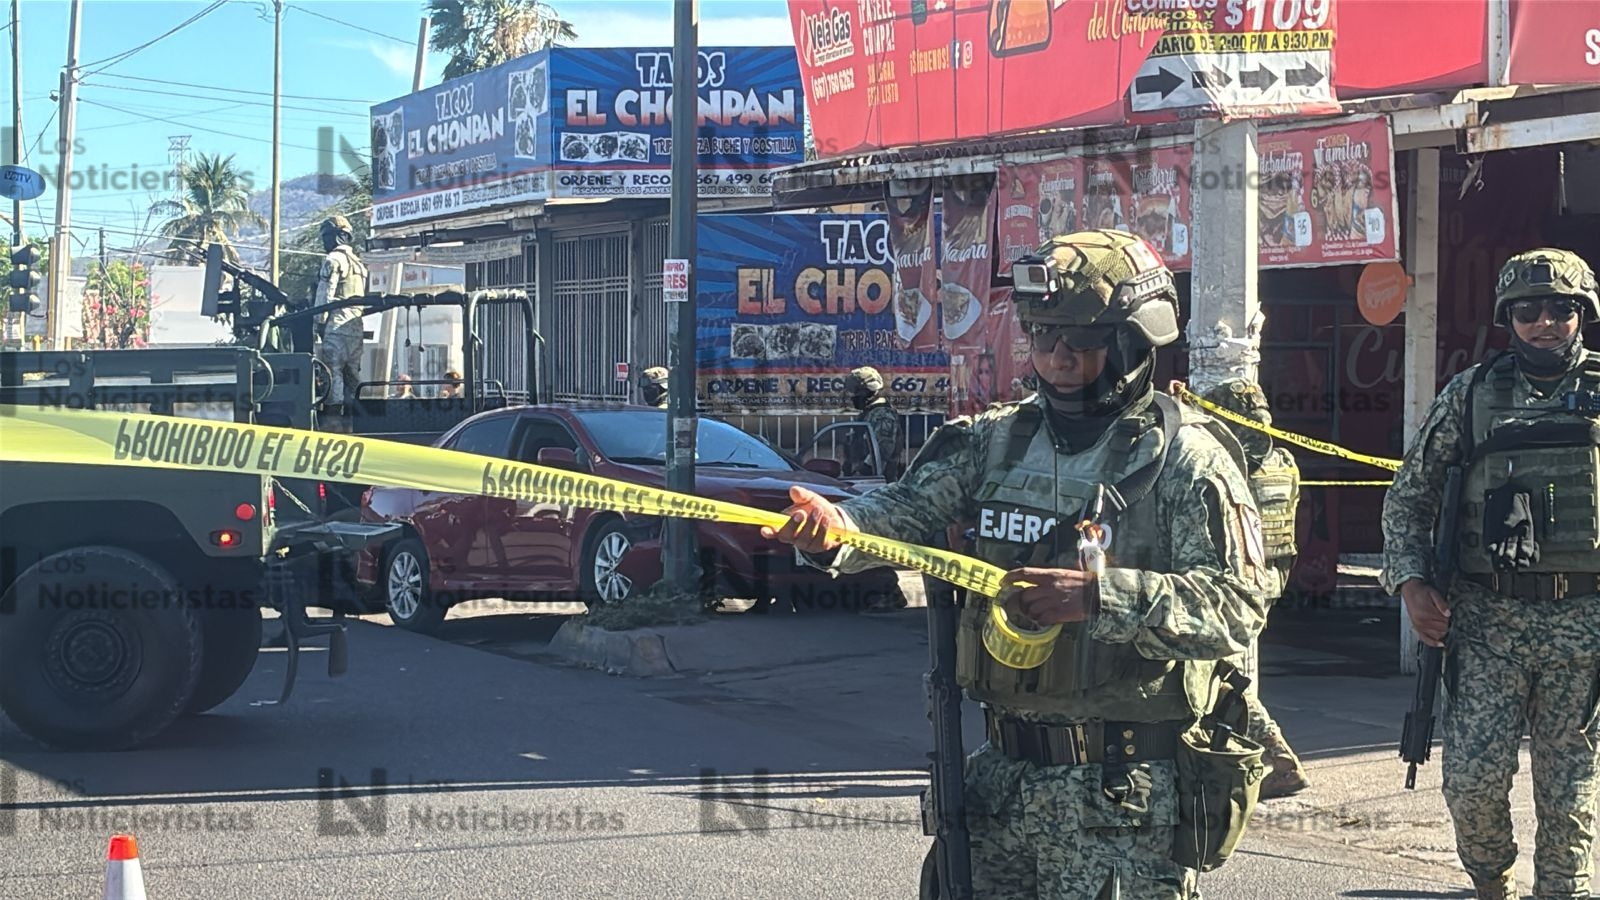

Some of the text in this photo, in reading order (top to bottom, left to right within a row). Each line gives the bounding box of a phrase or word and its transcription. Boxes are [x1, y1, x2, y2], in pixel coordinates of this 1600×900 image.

[808, 9, 851, 50] Vela Gas
[1249, 33, 1268, 50] PM
[1270, 34, 1279, 49] A
[1282, 32, 1309, 50] 9:30
[1311, 32, 1329, 48] PM
[635, 51, 726, 88] TAOS
[435, 82, 474, 122] TACOS
[565, 87, 797, 127] EL CHNPAN
[407, 106, 504, 160] EL CHONPAN
[712, 137, 741, 156] BUCHE
[743, 138, 751, 155] Y
[752, 136, 797, 156] COSTILLA
[618, 175, 627, 186] Y
[725, 174, 753, 186] 499
[421, 197, 432, 212] 667
[432, 194, 444, 209] 499
[820, 219, 894, 265] TAC
[736, 267, 786, 315] EL
[840, 329, 871, 351] TRIPA
[891, 377, 927, 393] 667
